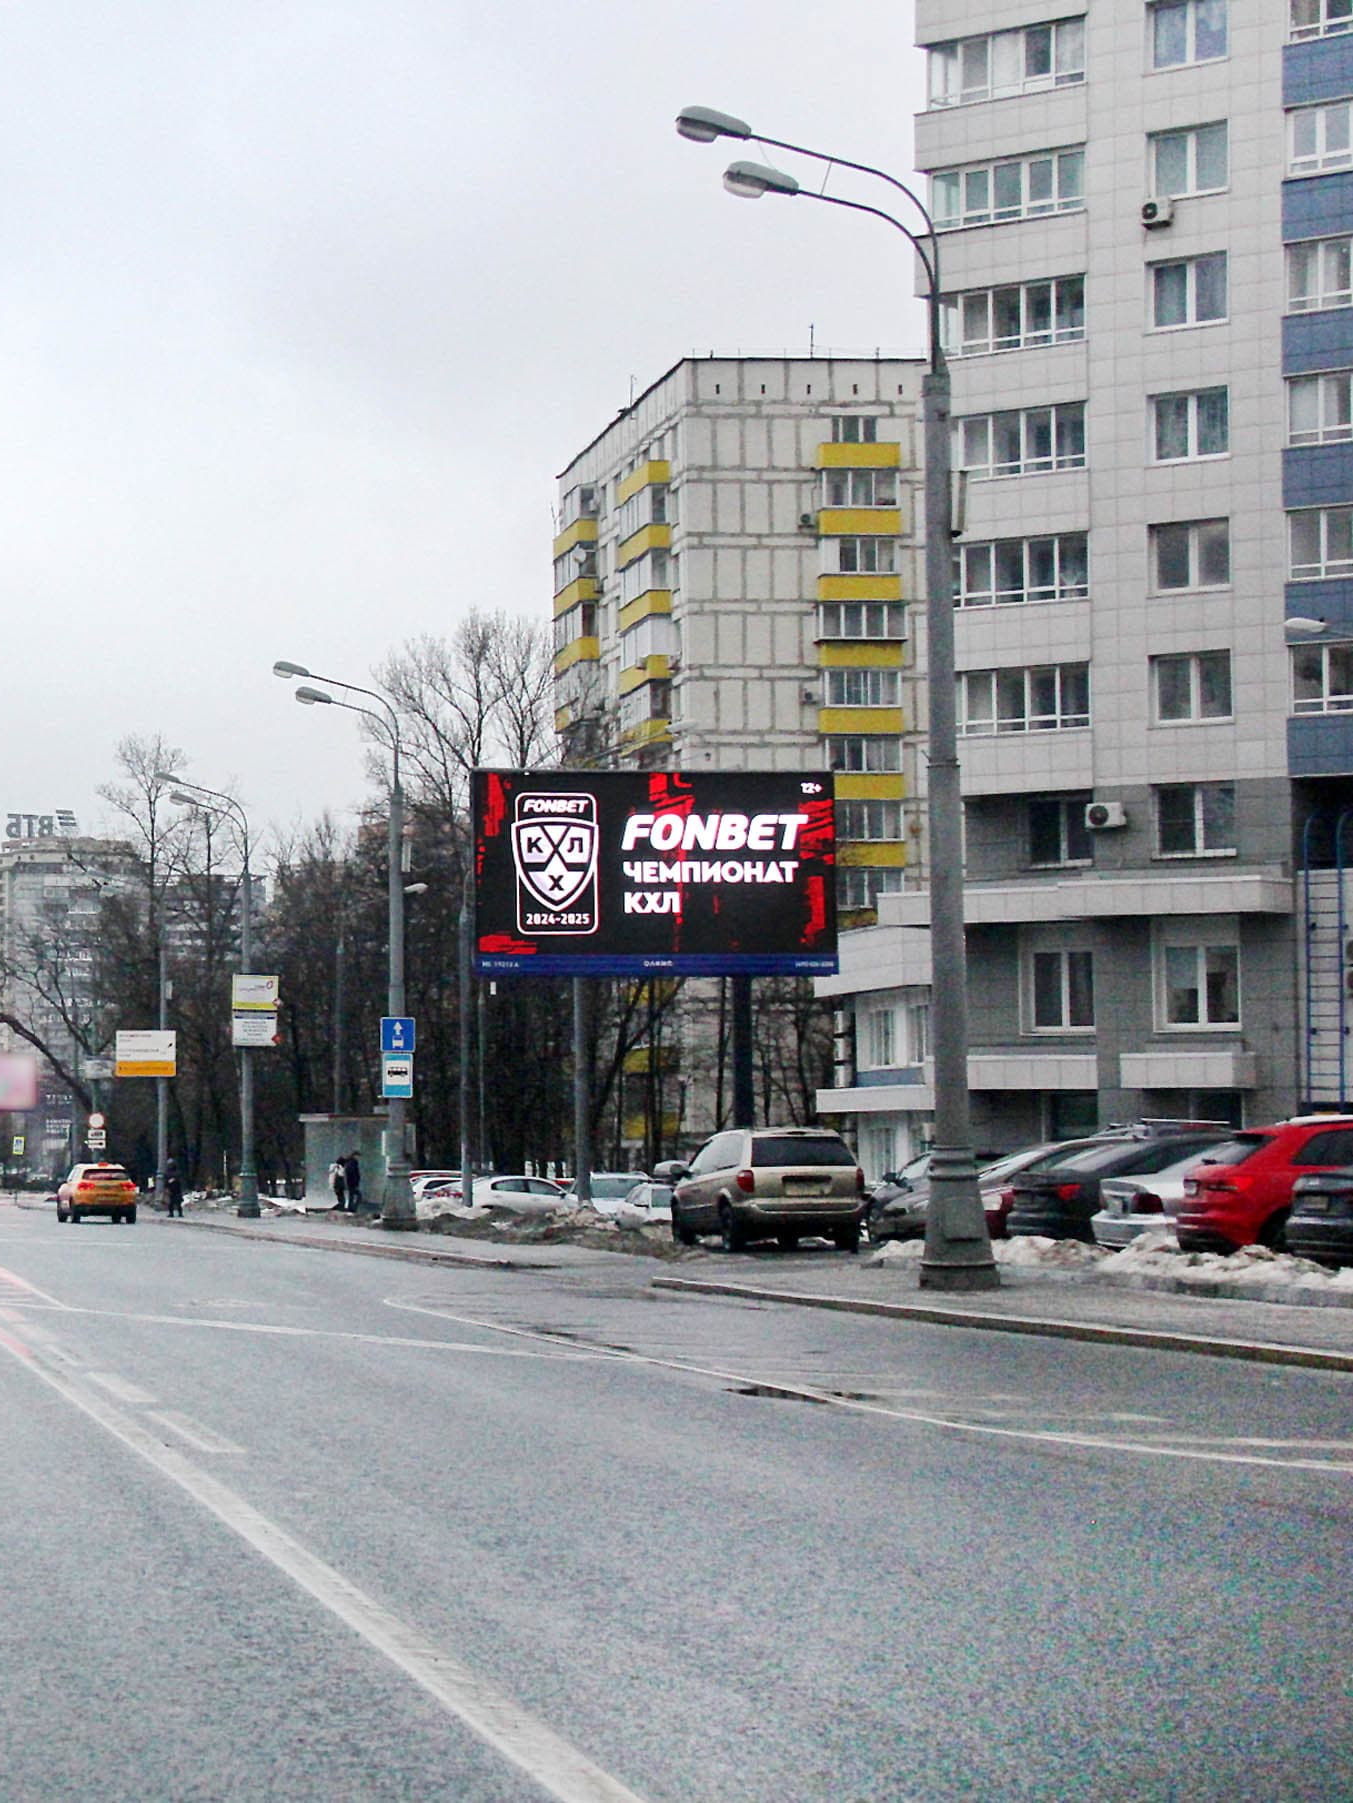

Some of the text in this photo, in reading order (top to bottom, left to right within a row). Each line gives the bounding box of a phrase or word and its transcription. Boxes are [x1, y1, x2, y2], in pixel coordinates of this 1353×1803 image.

[800, 783, 822, 793] 12+
[523, 799, 588, 813] FONBET
[621, 814, 808, 850] FONBET
[623, 861, 798, 883] ЧЕМПИОНАТ
[624, 892, 681, 913] КХЛ
[526, 913, 590, 924] 2024-2025
